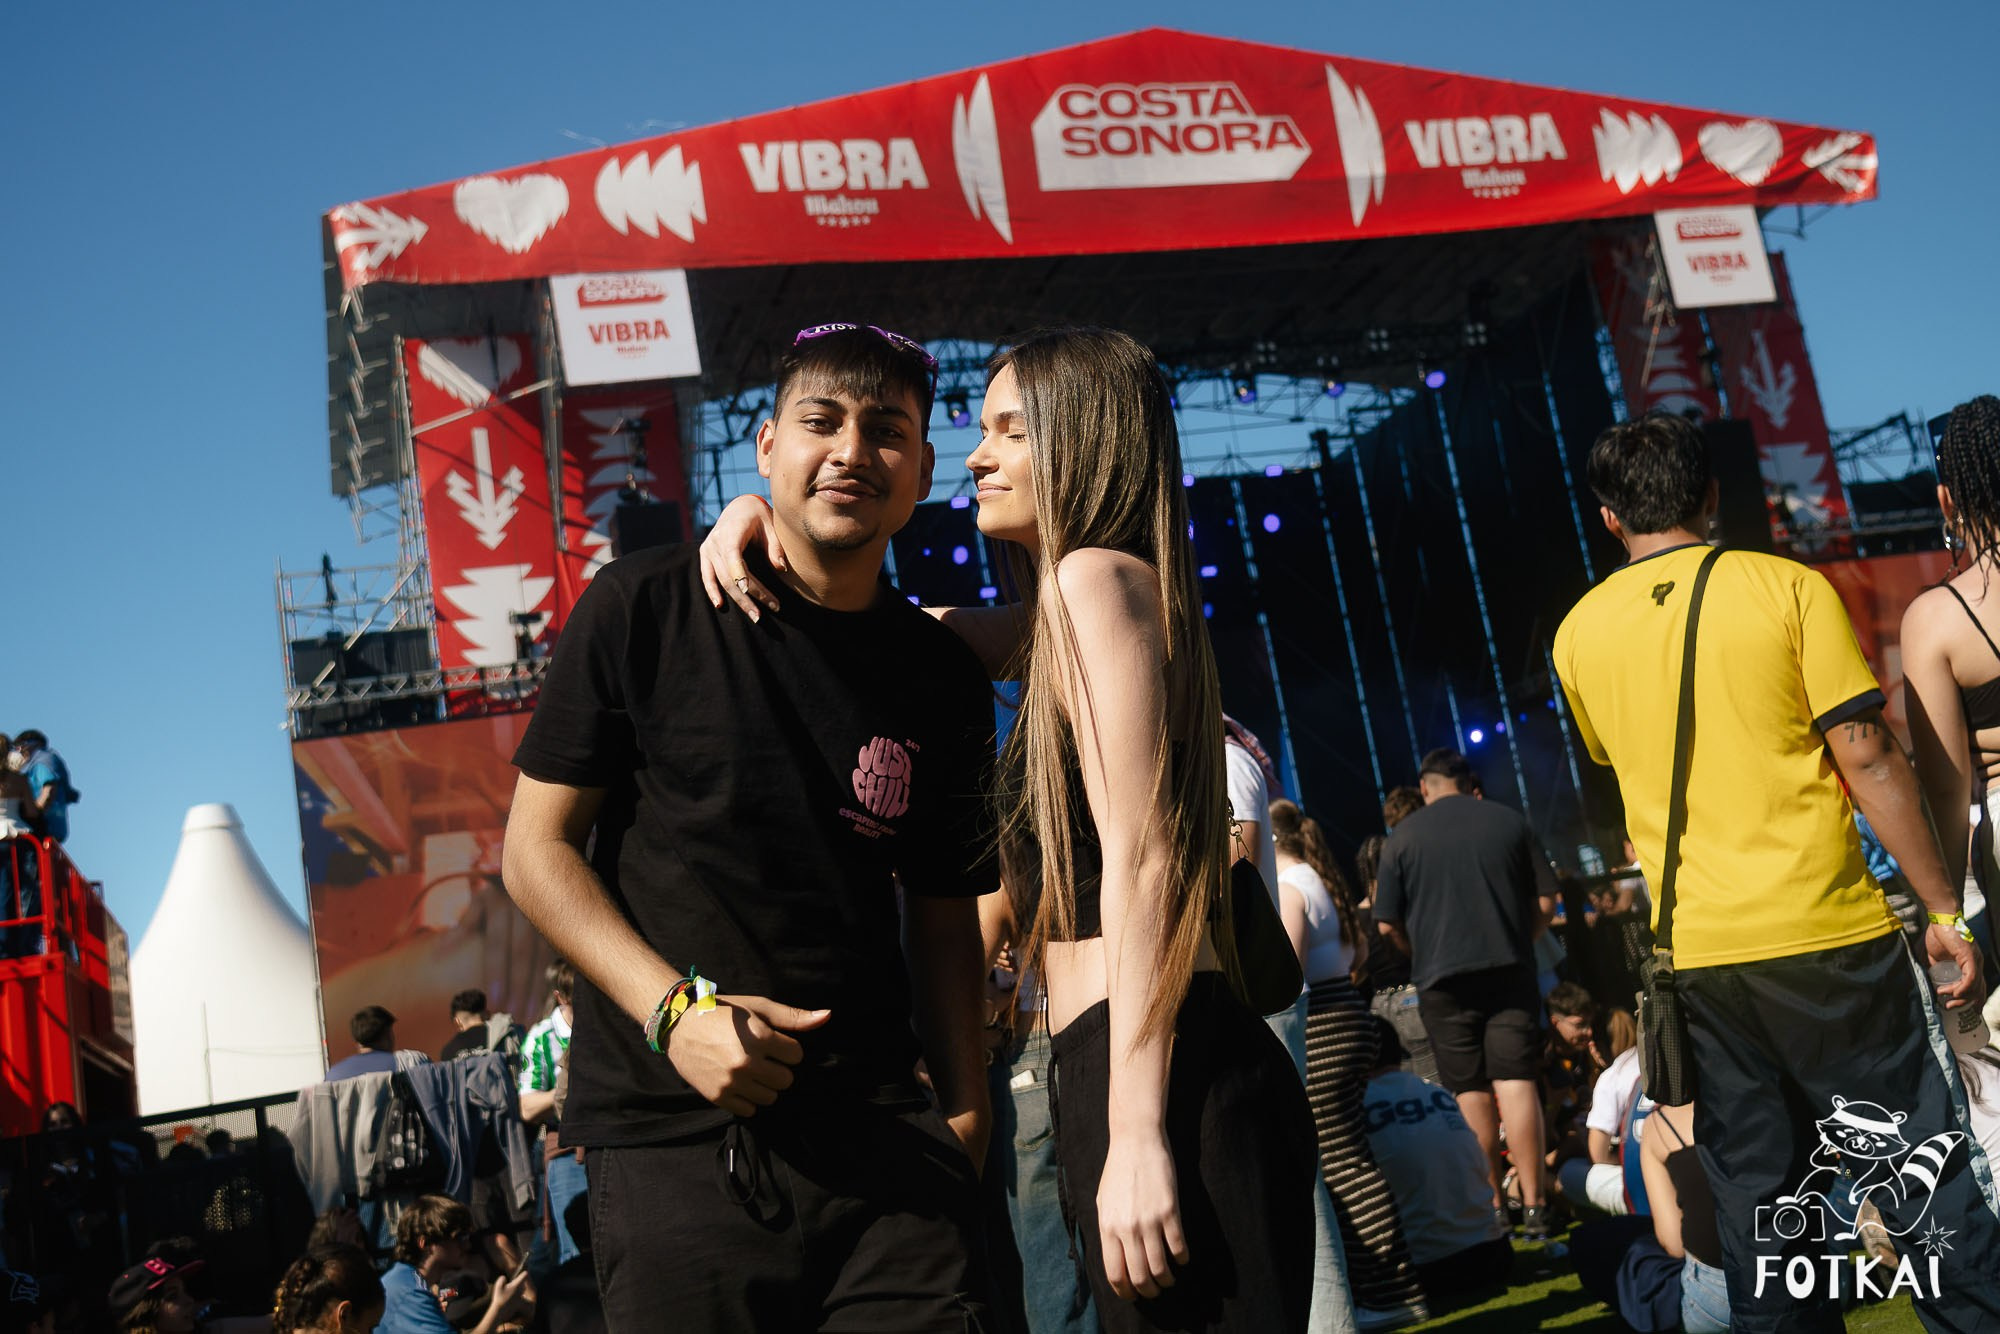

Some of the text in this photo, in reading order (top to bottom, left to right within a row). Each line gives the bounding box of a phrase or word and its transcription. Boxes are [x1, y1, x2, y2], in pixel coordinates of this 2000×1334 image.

[1057, 86, 1249, 120] COSTA
[1060, 120, 1305, 158] SONORA
[1403, 112, 1568, 168] VIBRA
[738, 136, 930, 193] VIBRA
[1686, 252, 1750, 272] VIBRA
[588, 319, 671, 345] VIBRA
[858, 736, 912, 786] JUST
[852, 768, 910, 818] CHILL
